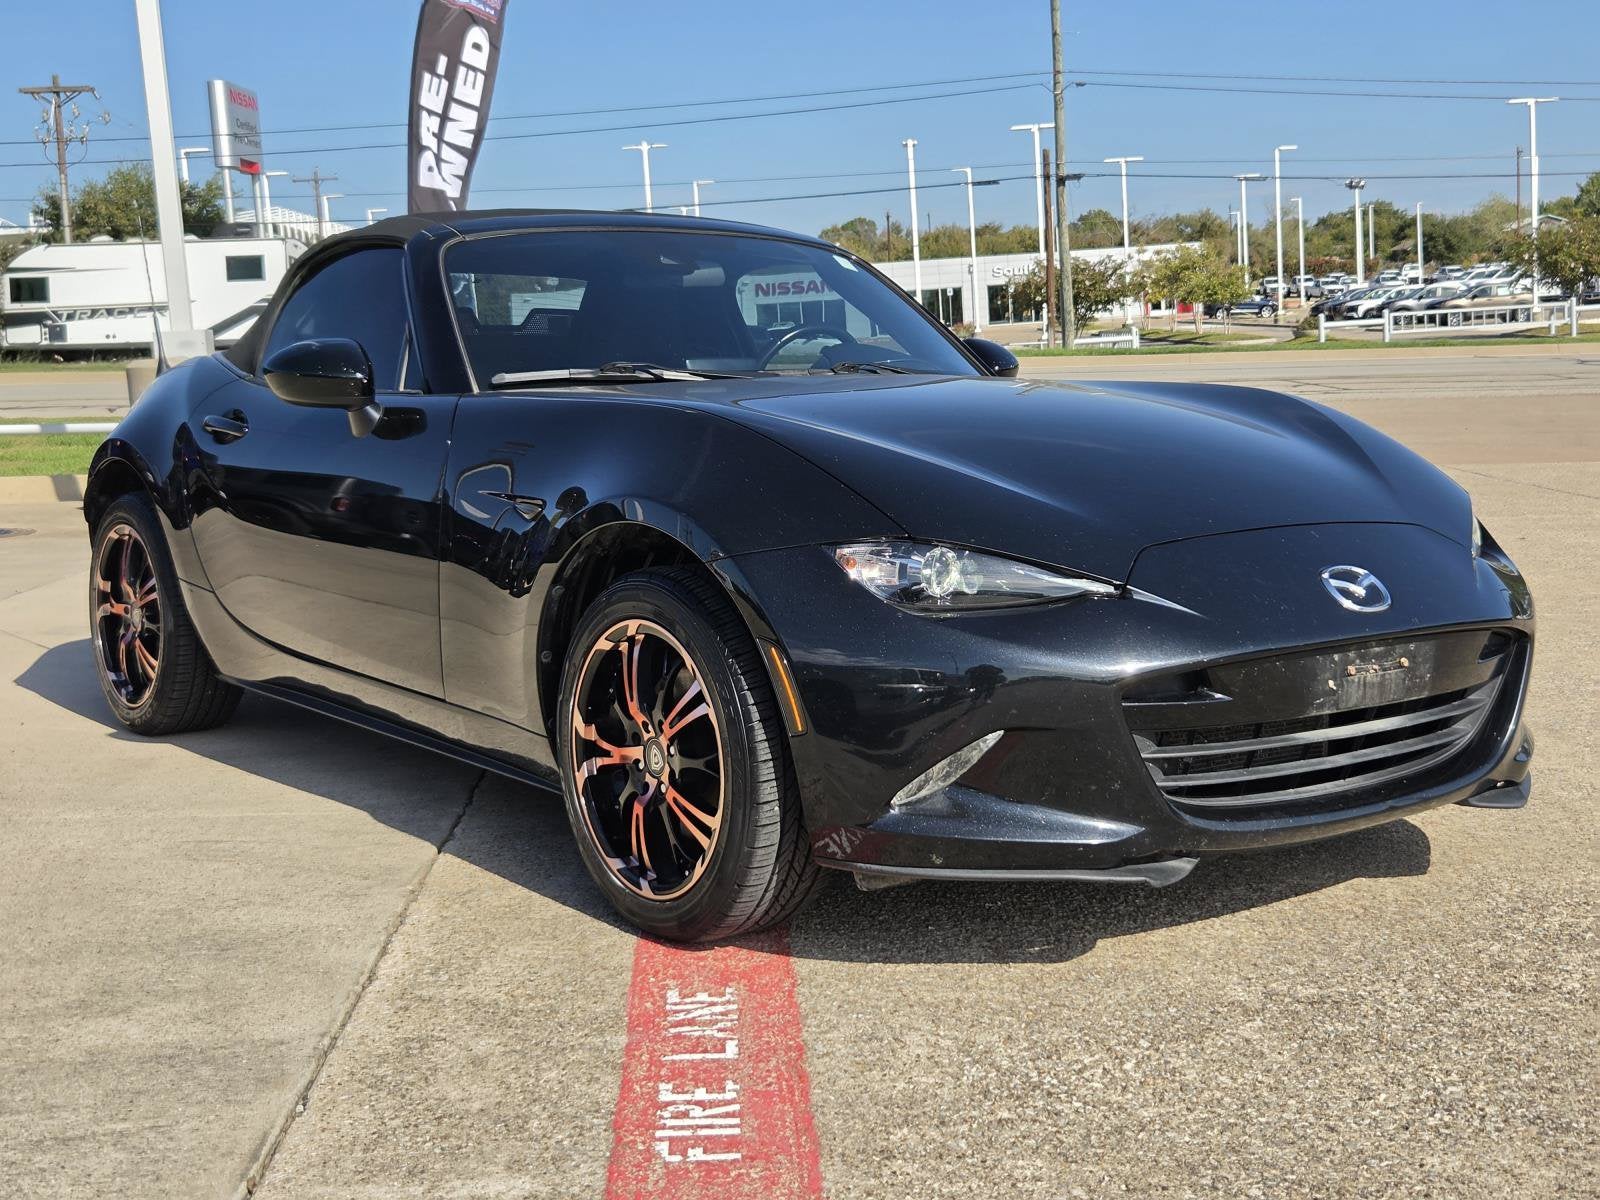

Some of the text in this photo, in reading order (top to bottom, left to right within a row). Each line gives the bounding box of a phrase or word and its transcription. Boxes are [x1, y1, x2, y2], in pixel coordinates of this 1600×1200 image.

[229, 88, 258, 111] NISSAN
[418, 53, 448, 190] PRE-
[439, 25, 490, 212] WNED
[654, 986, 742, 1163] FIRE LANE
